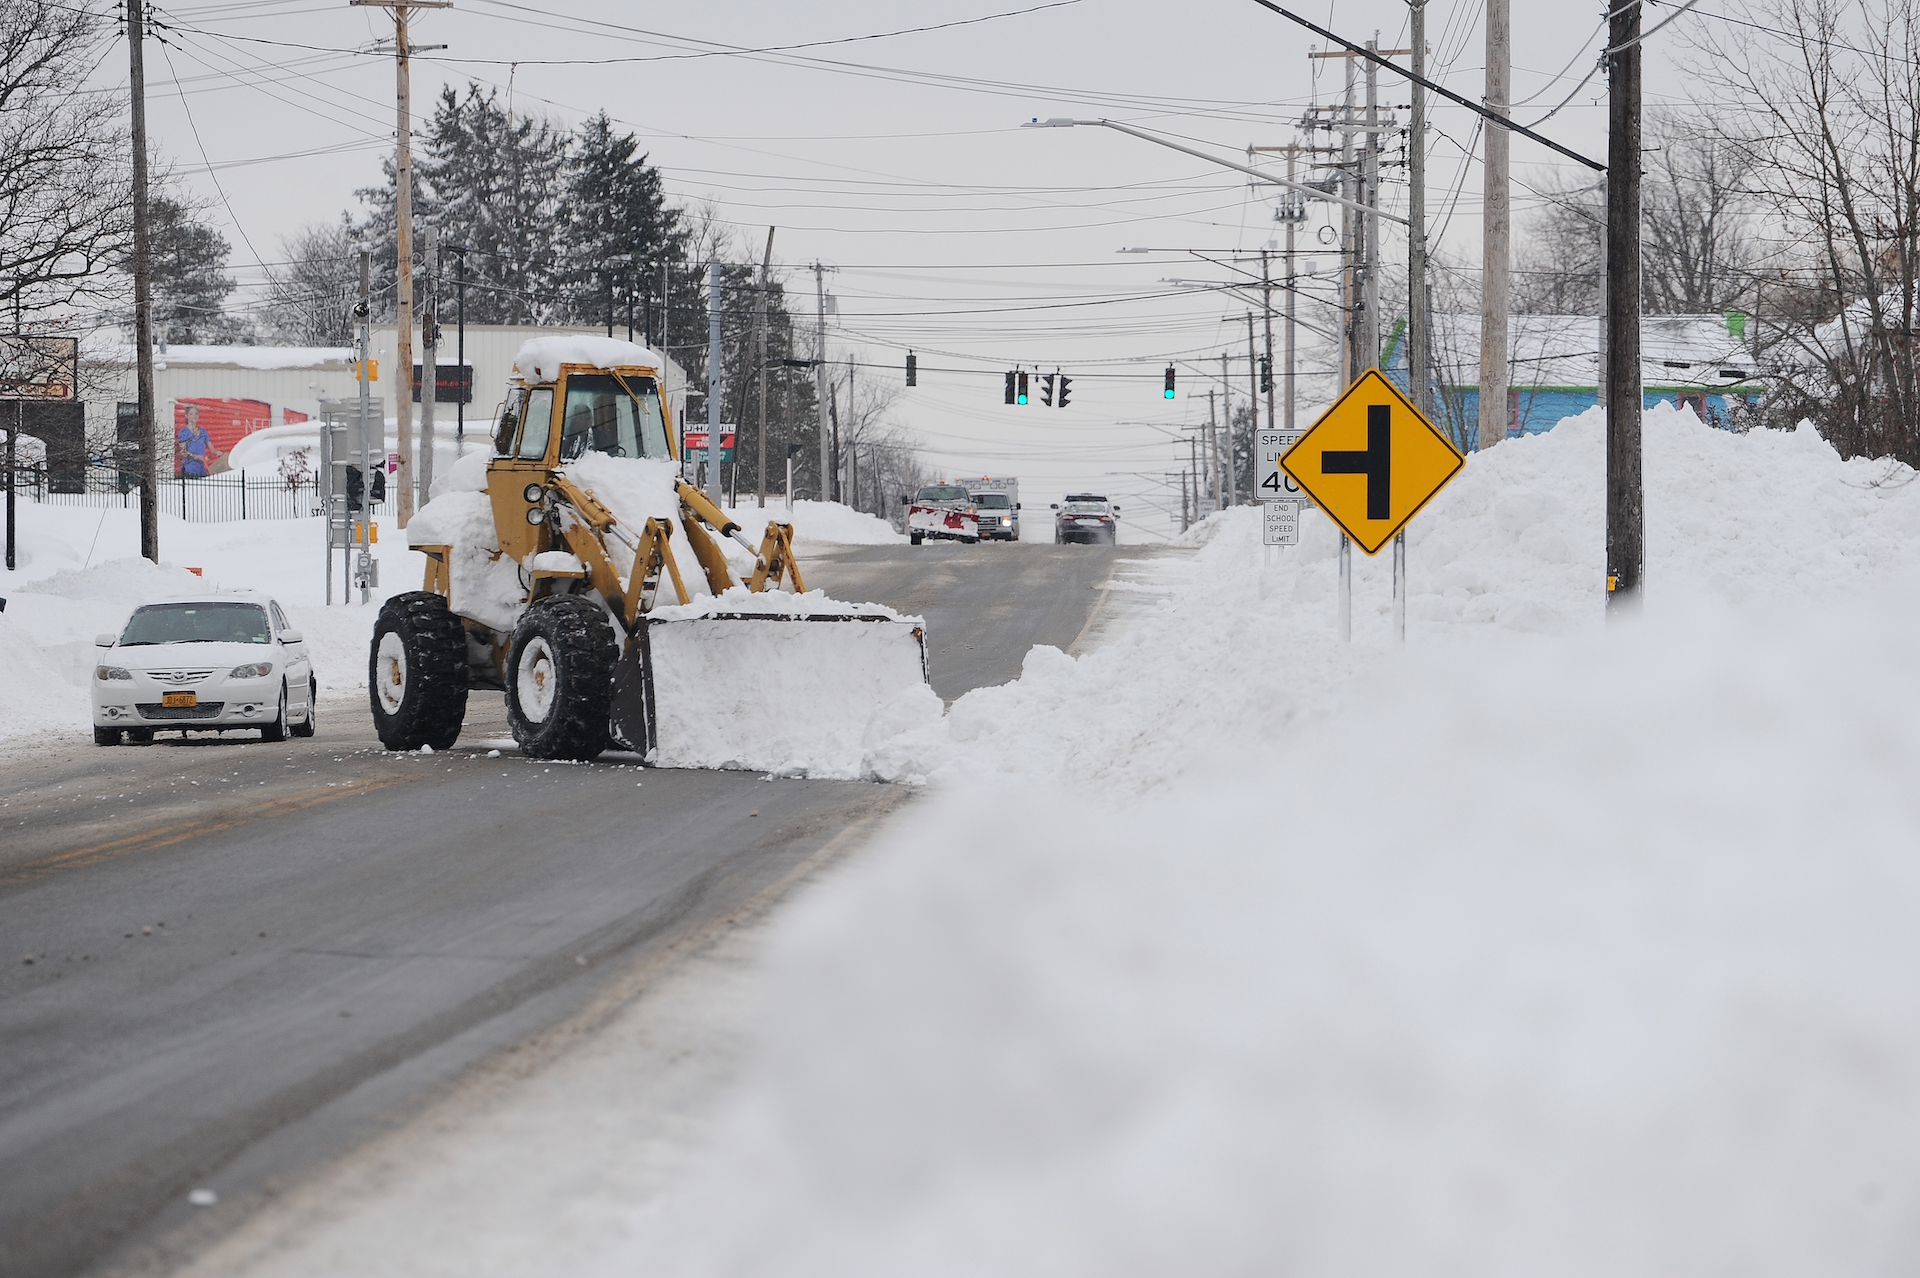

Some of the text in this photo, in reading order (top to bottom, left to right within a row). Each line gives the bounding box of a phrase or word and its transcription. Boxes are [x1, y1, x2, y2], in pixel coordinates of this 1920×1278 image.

[245, 417, 270, 435] NEE
[1261, 471, 1300, 493] 40
[1269, 525, 1294, 533] SPEED
